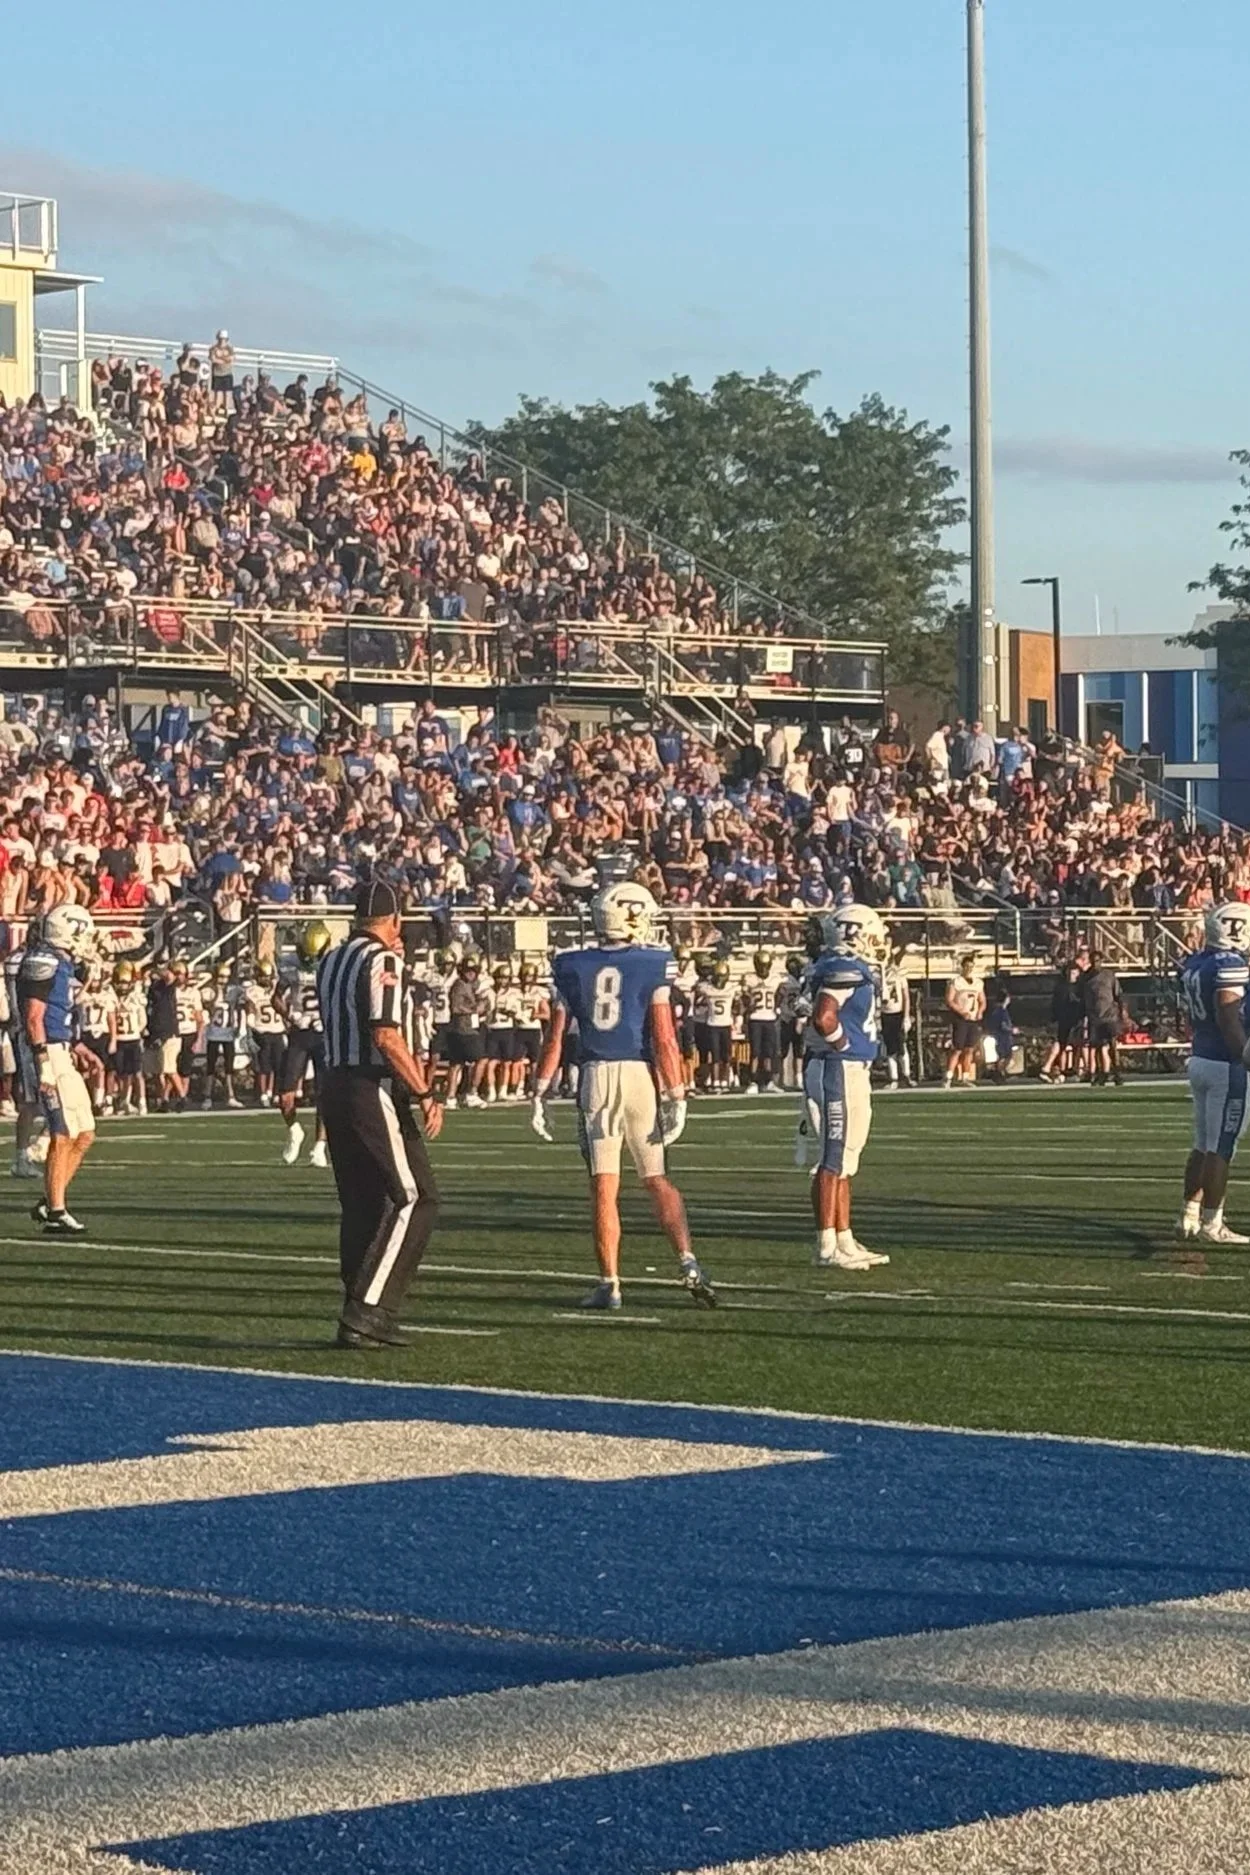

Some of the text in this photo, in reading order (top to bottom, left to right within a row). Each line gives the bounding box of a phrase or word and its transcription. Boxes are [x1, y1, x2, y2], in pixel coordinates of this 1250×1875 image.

[1221, 917, 1247, 938] T
[593, 967, 622, 1031] 8
[714, 1000, 726, 1015] 5
